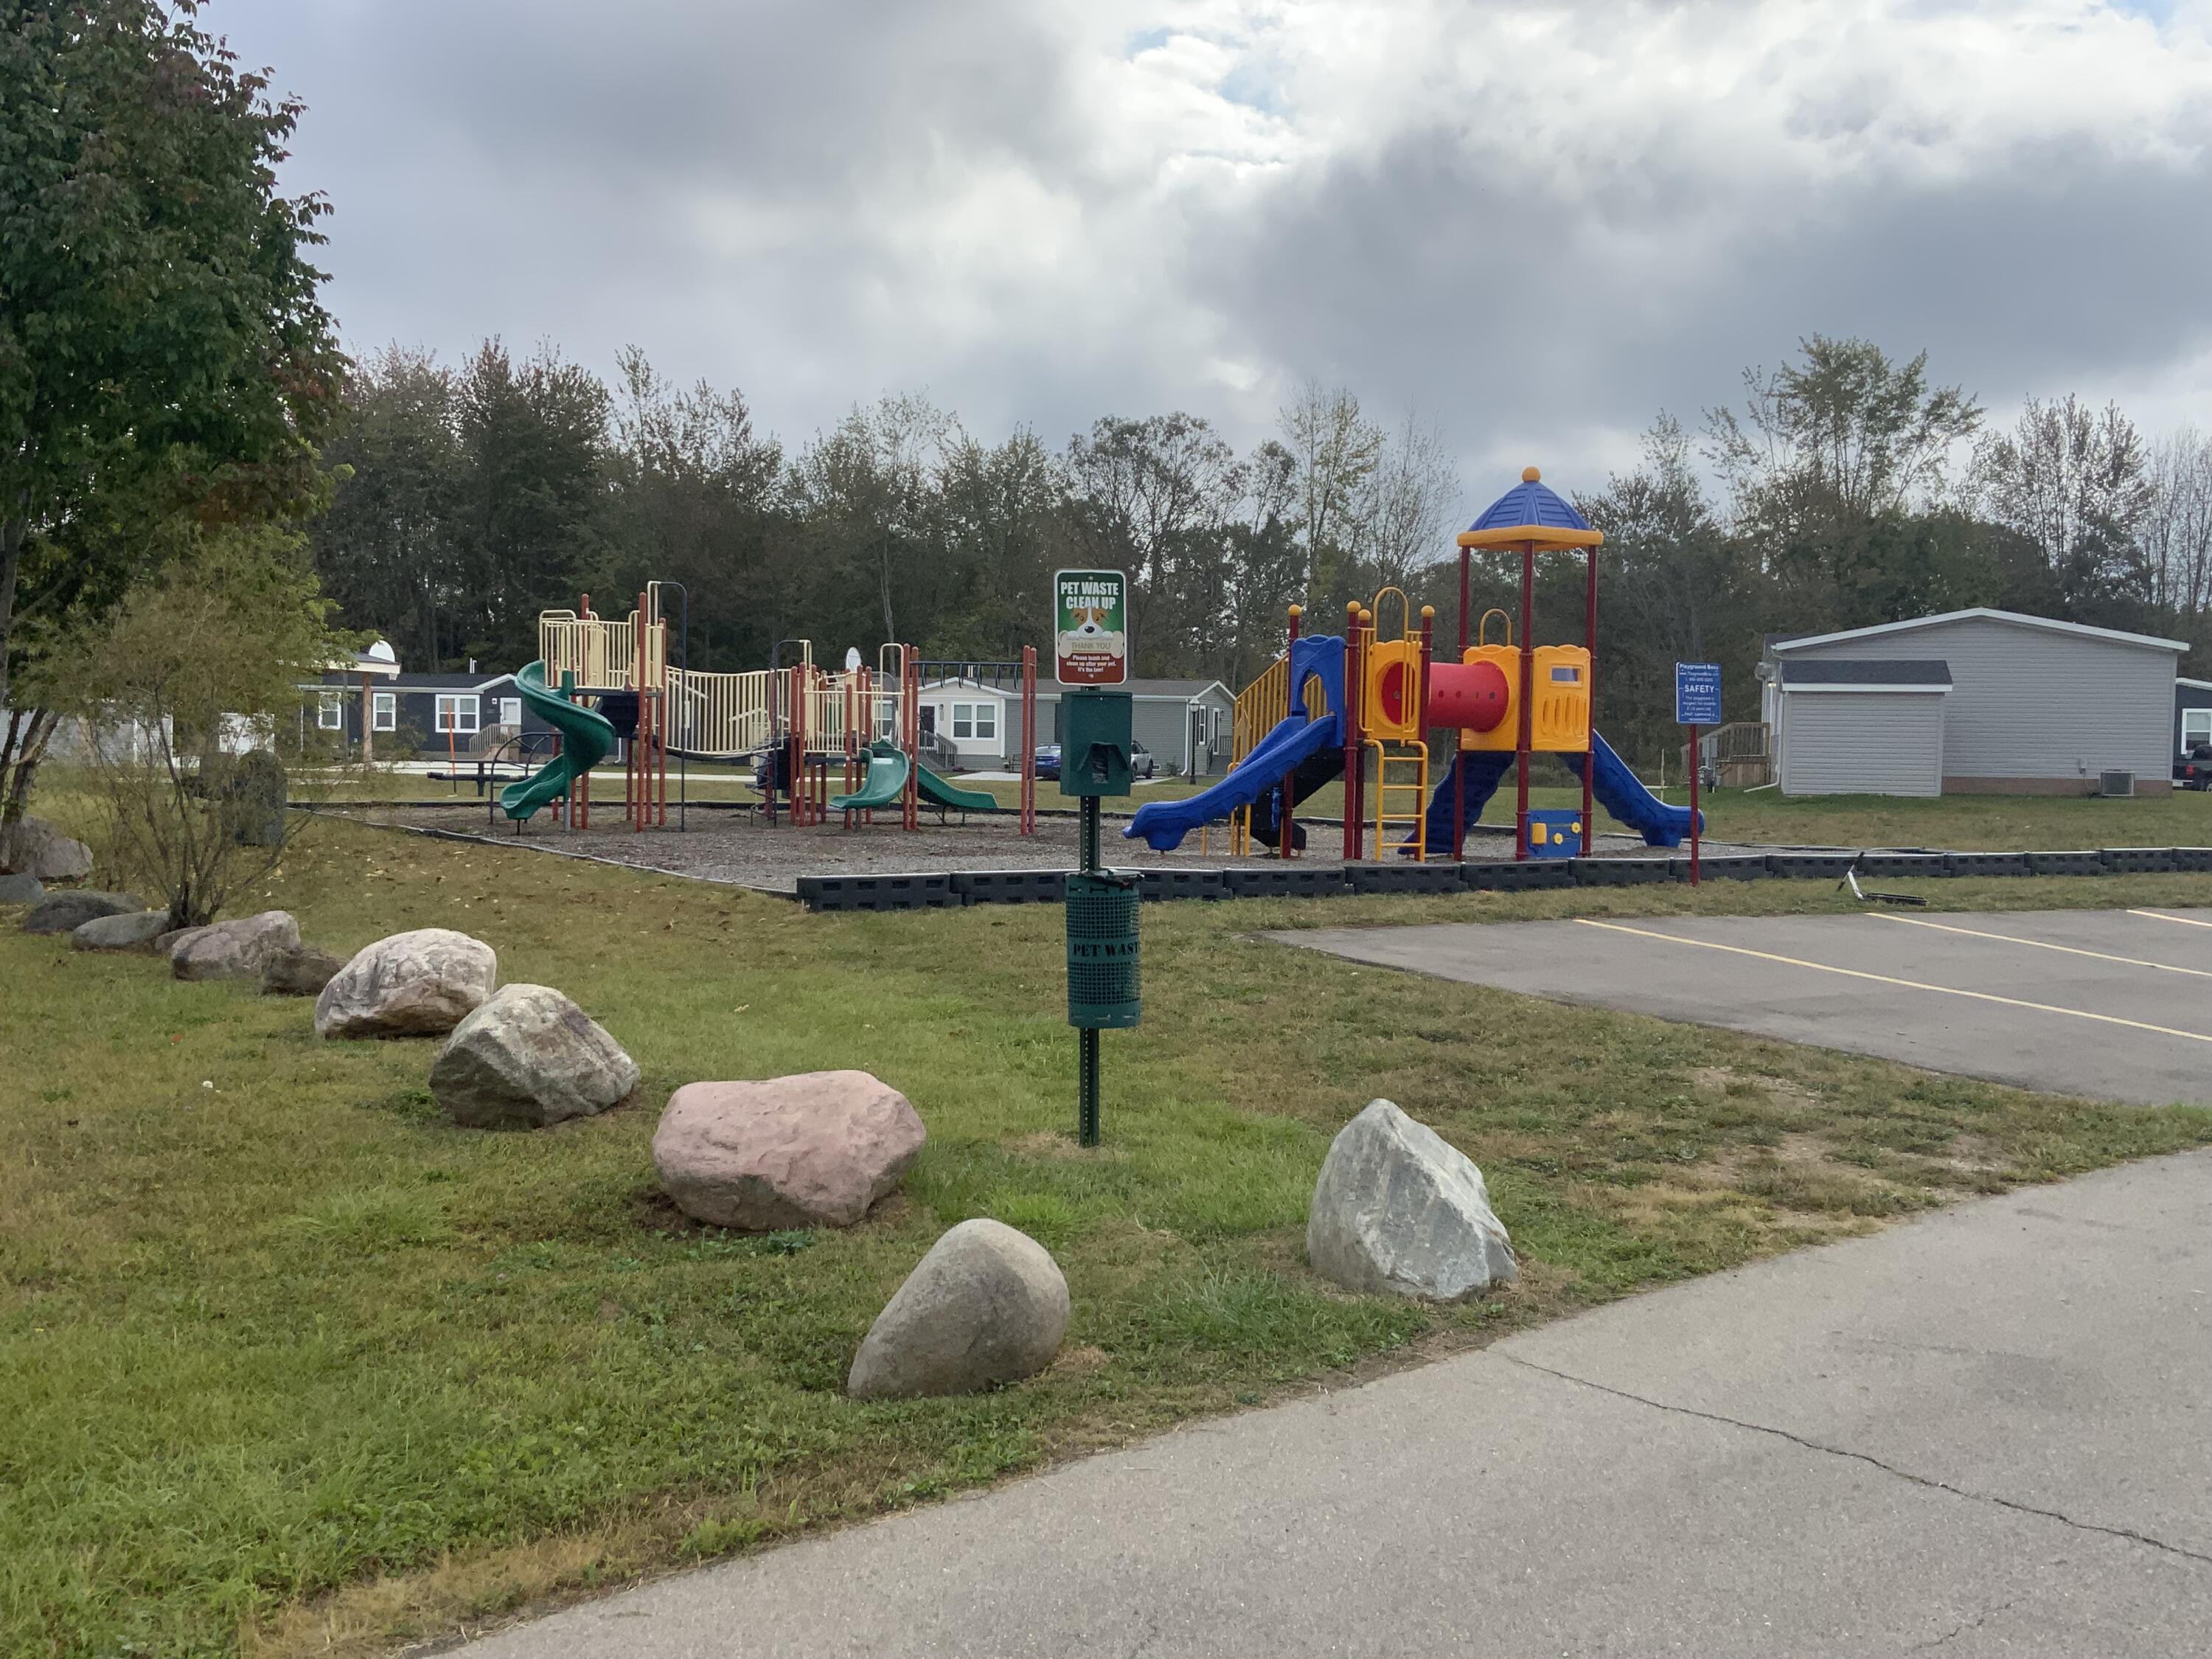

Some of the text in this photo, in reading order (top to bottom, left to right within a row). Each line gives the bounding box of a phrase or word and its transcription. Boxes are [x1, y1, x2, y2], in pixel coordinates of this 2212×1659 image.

[1060, 582, 1119, 595] PET WASTE
[1065, 596, 1116, 610] CLEAN UP
[1684, 684, 1714, 693] SAFETY
[1073, 942, 1140, 957] PET WAST
